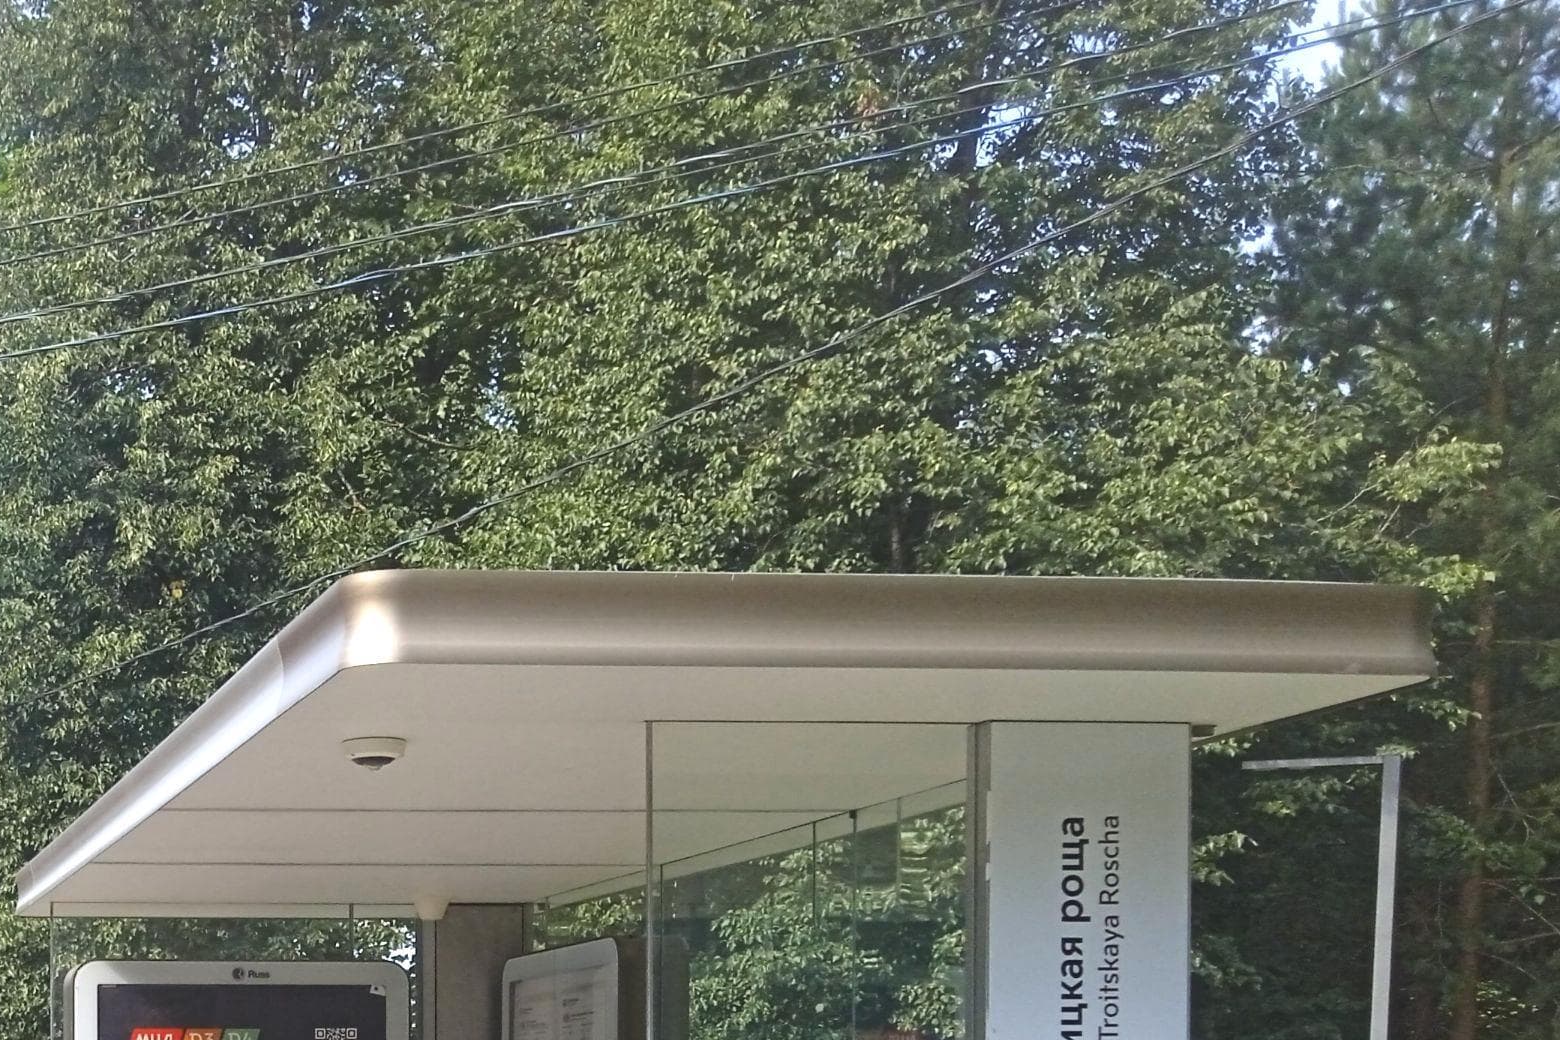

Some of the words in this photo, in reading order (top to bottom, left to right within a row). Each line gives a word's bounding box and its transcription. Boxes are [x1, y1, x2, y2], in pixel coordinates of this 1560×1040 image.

[1060, 816, 1091, 923] роща
[1098, 814, 1120, 905] Roscha
[248, 970, 270, 979] Russ
